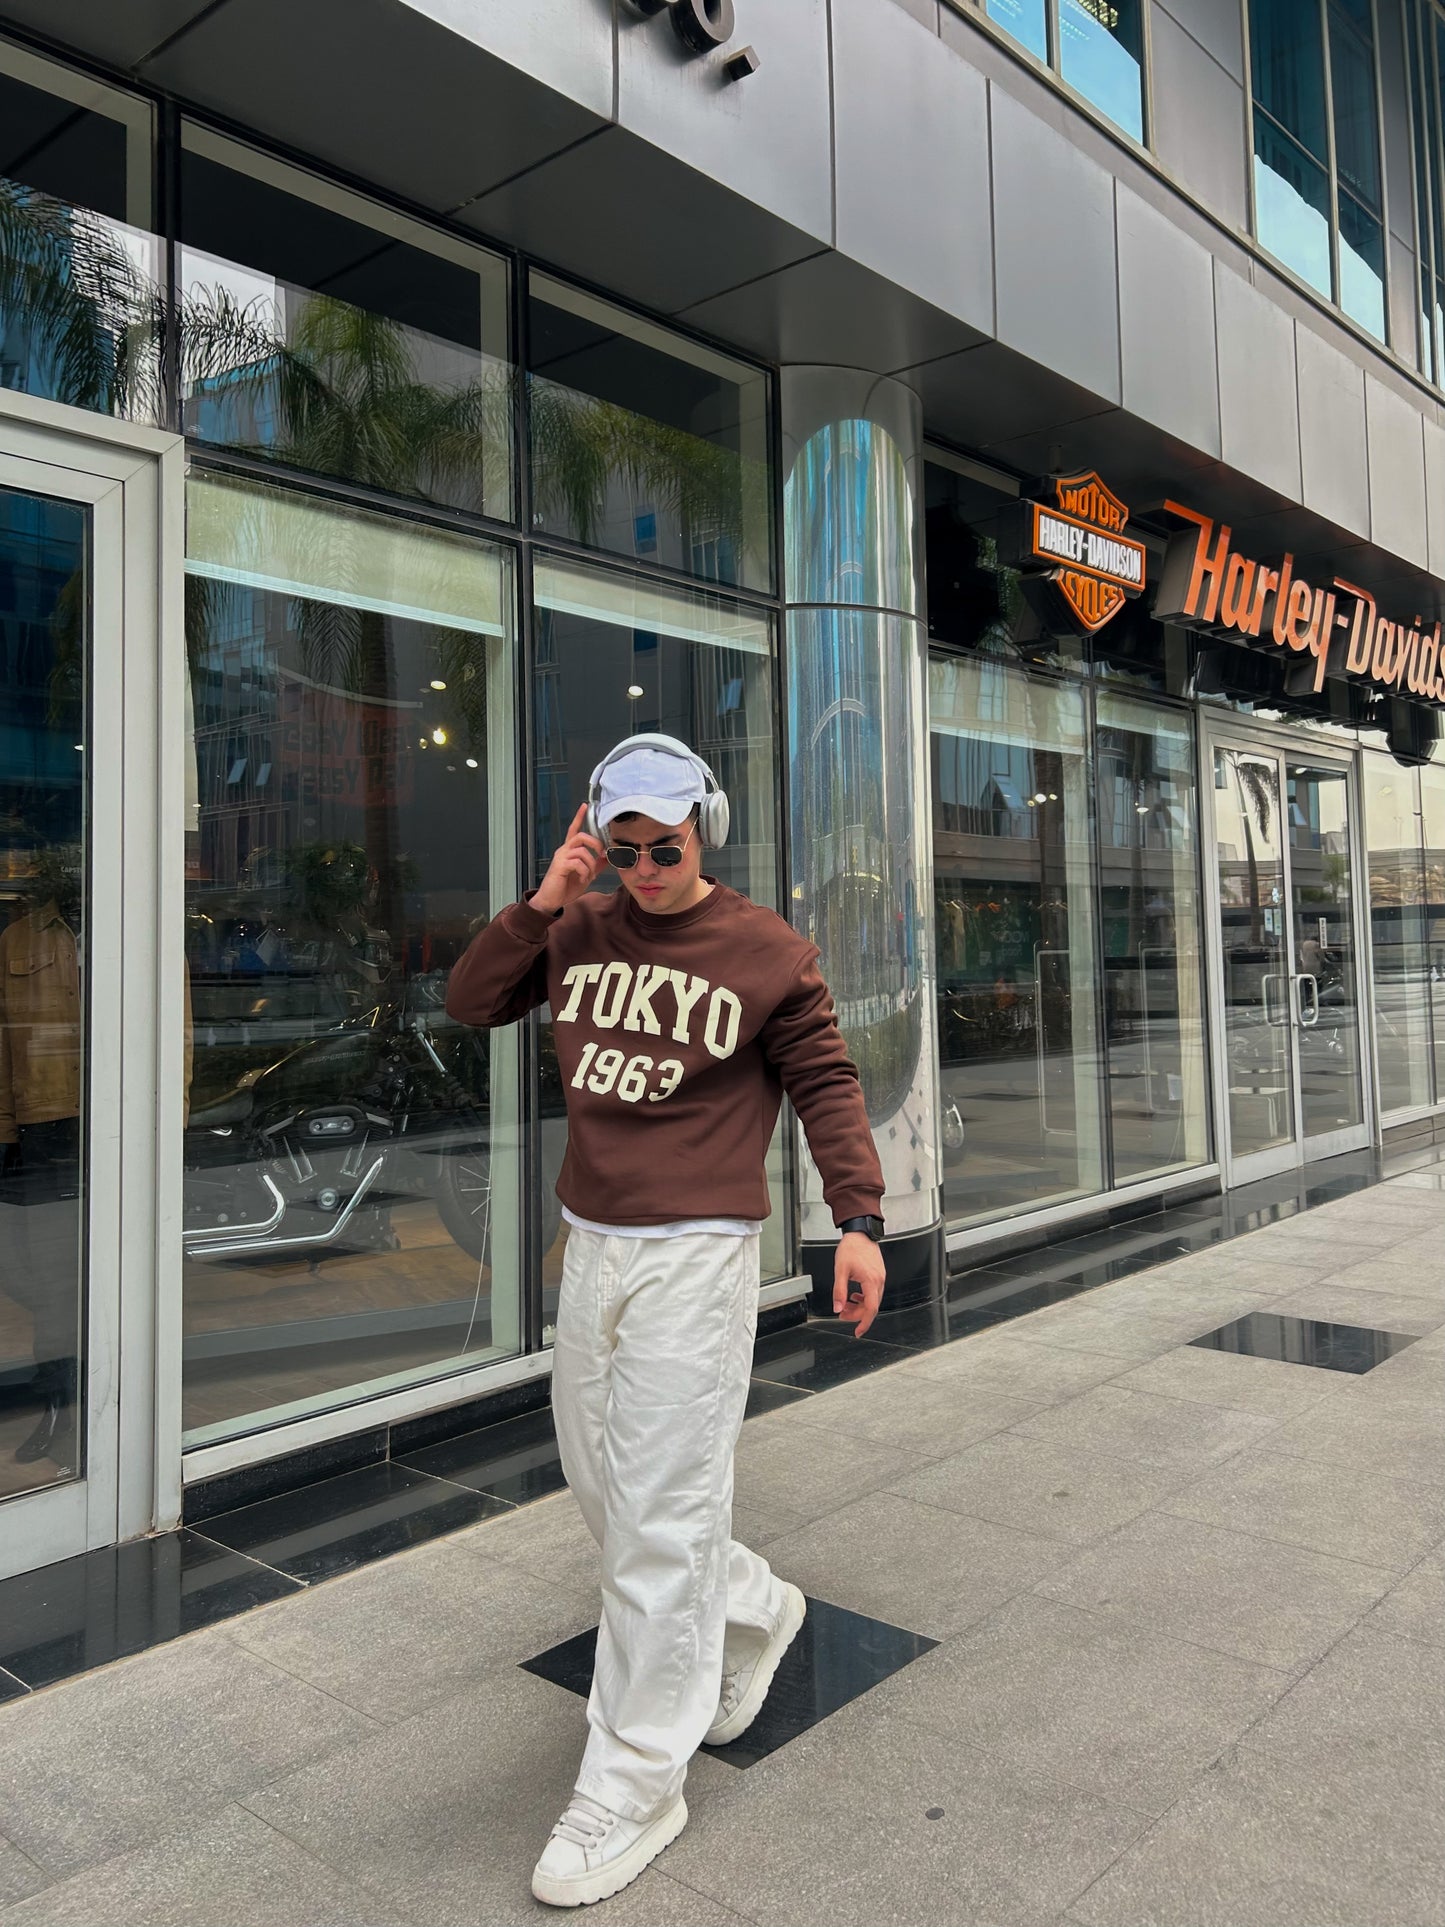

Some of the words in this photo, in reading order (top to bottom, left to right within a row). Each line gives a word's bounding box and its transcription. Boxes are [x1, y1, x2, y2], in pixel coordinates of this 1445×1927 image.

[1065, 482, 1121, 532] MOTOR
[1039, 514, 1142, 583] HARLEY-DAVIDSON
[1065, 571, 1119, 623] CYCLES
[556, 961, 743, 1060] TOKYO
[570, 1042, 685, 1103] 1963
